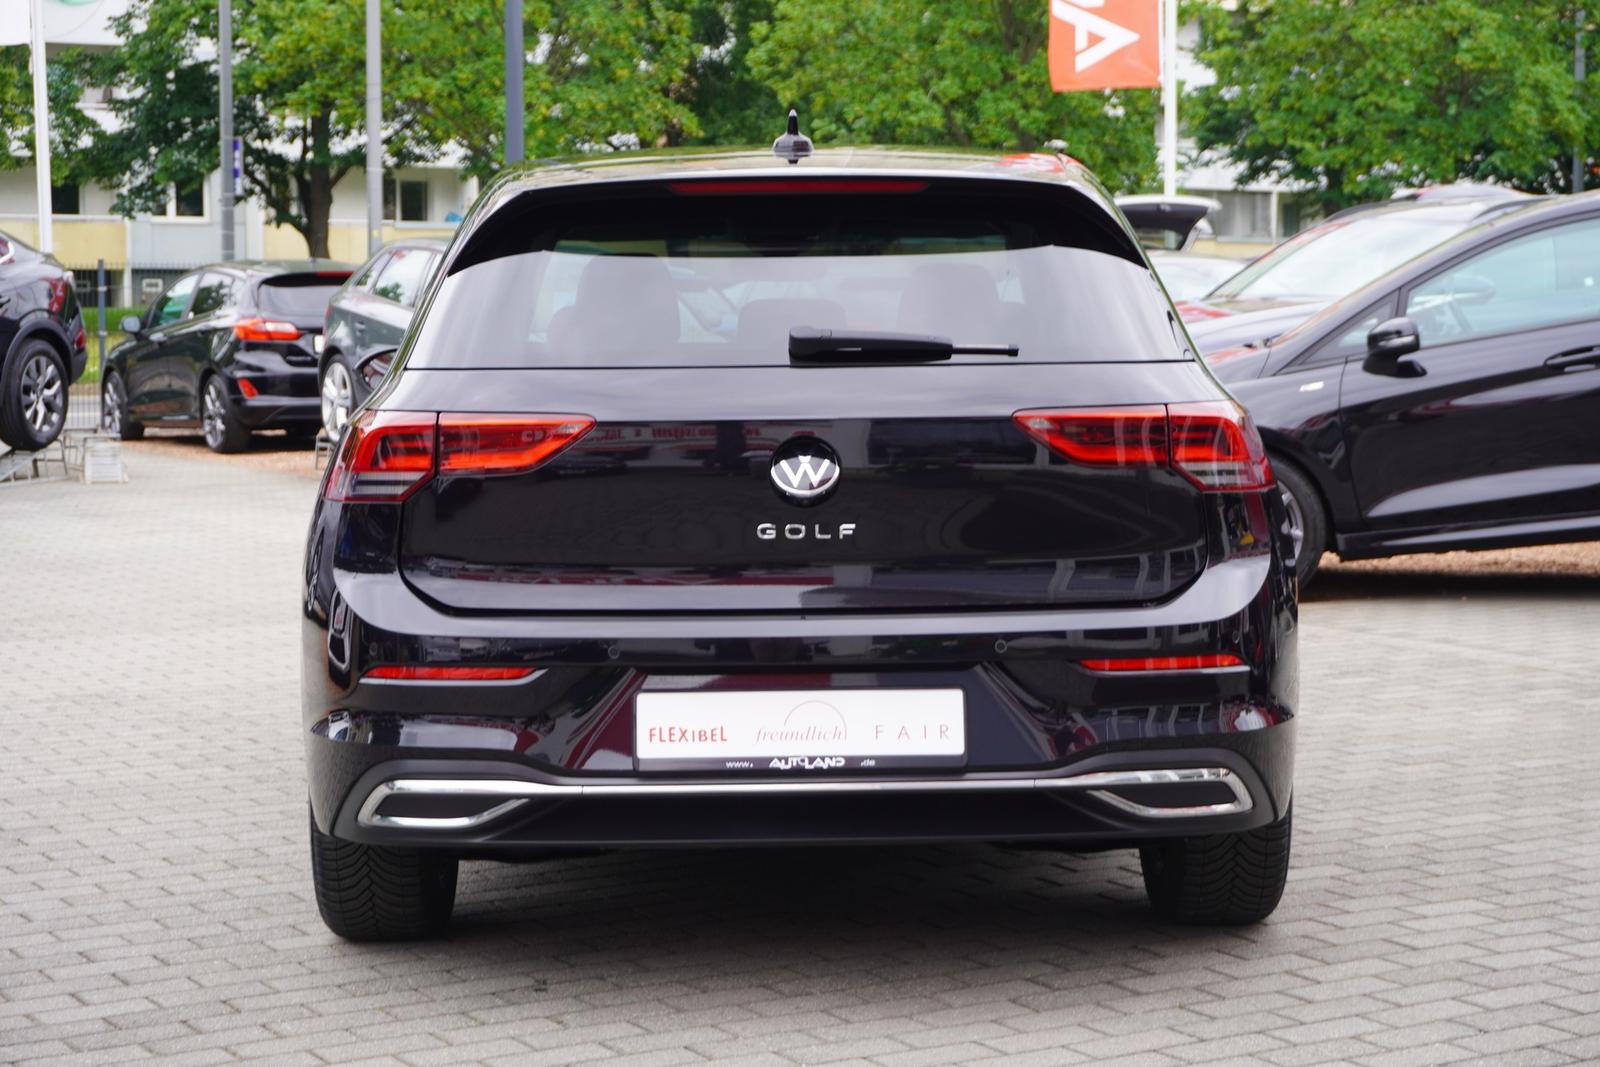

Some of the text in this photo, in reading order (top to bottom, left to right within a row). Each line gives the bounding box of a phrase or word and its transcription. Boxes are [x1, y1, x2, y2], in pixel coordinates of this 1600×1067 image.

[757, 523, 856, 539] GOLF
[648, 724, 951, 746] FLEXIBEL freundlich FAIR
[726, 760, 753, 769] www.
[769, 756, 846, 770] AUTOLAND
